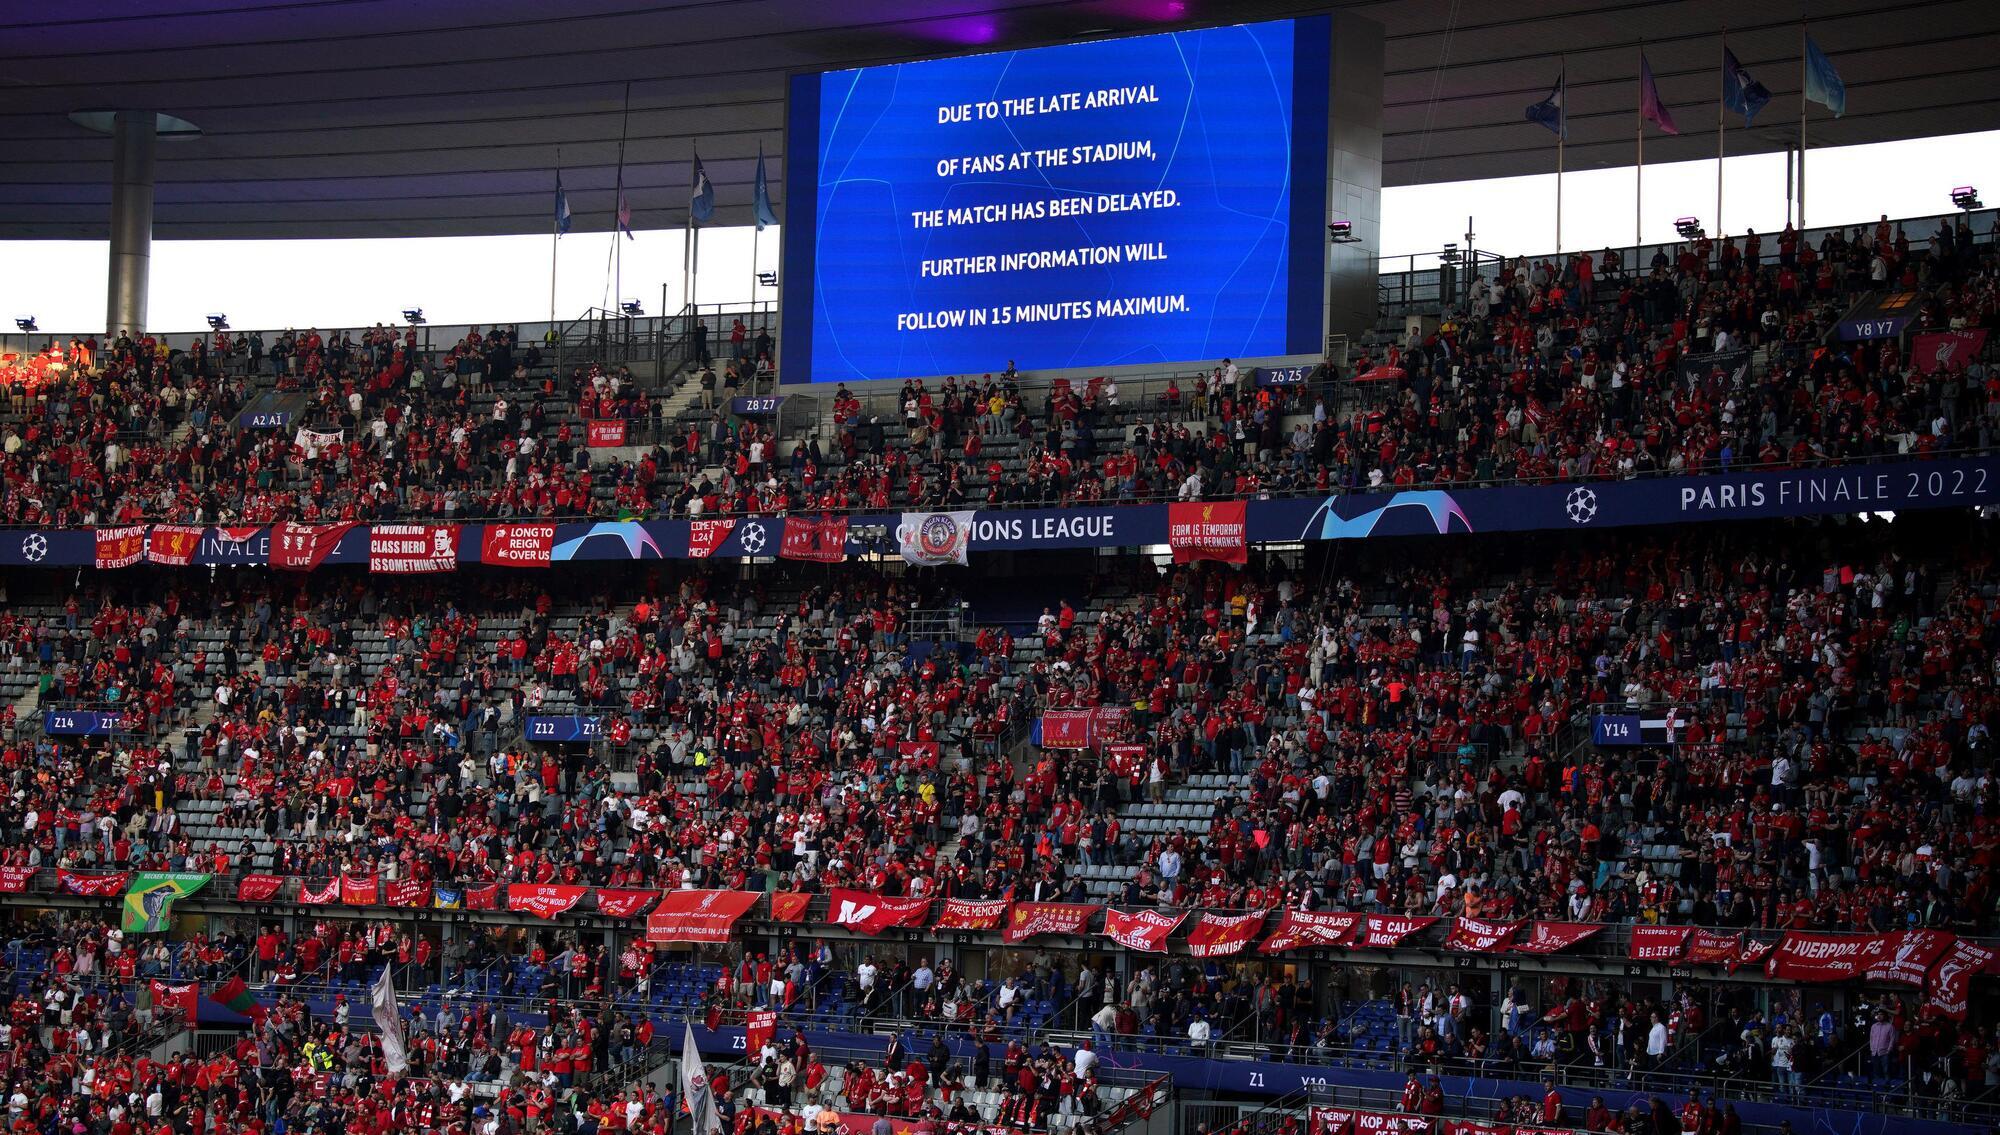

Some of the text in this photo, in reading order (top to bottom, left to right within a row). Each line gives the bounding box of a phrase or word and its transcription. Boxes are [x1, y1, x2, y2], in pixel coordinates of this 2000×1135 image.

[939, 86, 1158, 123] DUE TO THE LATE ARRIVAL
[937, 141, 1155, 176] OF FANS AT THE STADIUM,
[912, 190, 1181, 228] THE MATCH HAS BEEN DELAYED.
[922, 243, 1167, 277] FURTHER INFORMATION WILL
[898, 295, 1189, 330] FOLLOW IN 15 MINUTES MAXIMUM.
[1856, 321, 1893, 336] Y8 Y7
[1272, 370, 1302, 382] Z6 Z5
[746, 400, 774, 410] Z8 Z7
[252, 414, 282, 426] A2 A1
[1682, 468, 1988, 510] PARIS FINALE 2022
[380, 526, 424, 534] WORKING
[510, 528, 553, 537] LONG TO
[1032, 515, 1114, 539] LEAGUE
[1202, 524, 1243, 535] TEMPORARY
[201, 538, 269, 556] INALE
[371, 541, 426, 553] CLASS HERO
[510, 539, 539, 549] REIGN
[510, 551, 550, 560] OVER US
[96, 559, 104, 569] OF
[371, 558, 382, 571] IS
[382, 559, 436, 572] SOMETHING
[55, 718, 74, 728] Z14
[535, 723, 554, 734] Z12
[1604, 724, 1628, 736] Y14
[947, 904, 970, 916] THESE
[1291, 911, 1352, 927] THERE ARE PLACES
[1369, 919, 1382, 930] WE
[1459, 917, 1507, 936] THERE IS
[1639, 946, 1680, 957] BELIEVE
[1782, 938, 1861, 958] LIVERPOOL
[1861, 940, 1885, 955] FC
[733, 1036, 746, 1049] Z3
[1250, 1073, 1264, 1087] Z1
[1301, 1076, 1326, 1092] Y10
[1360, 1116, 1383, 1128] KOP
